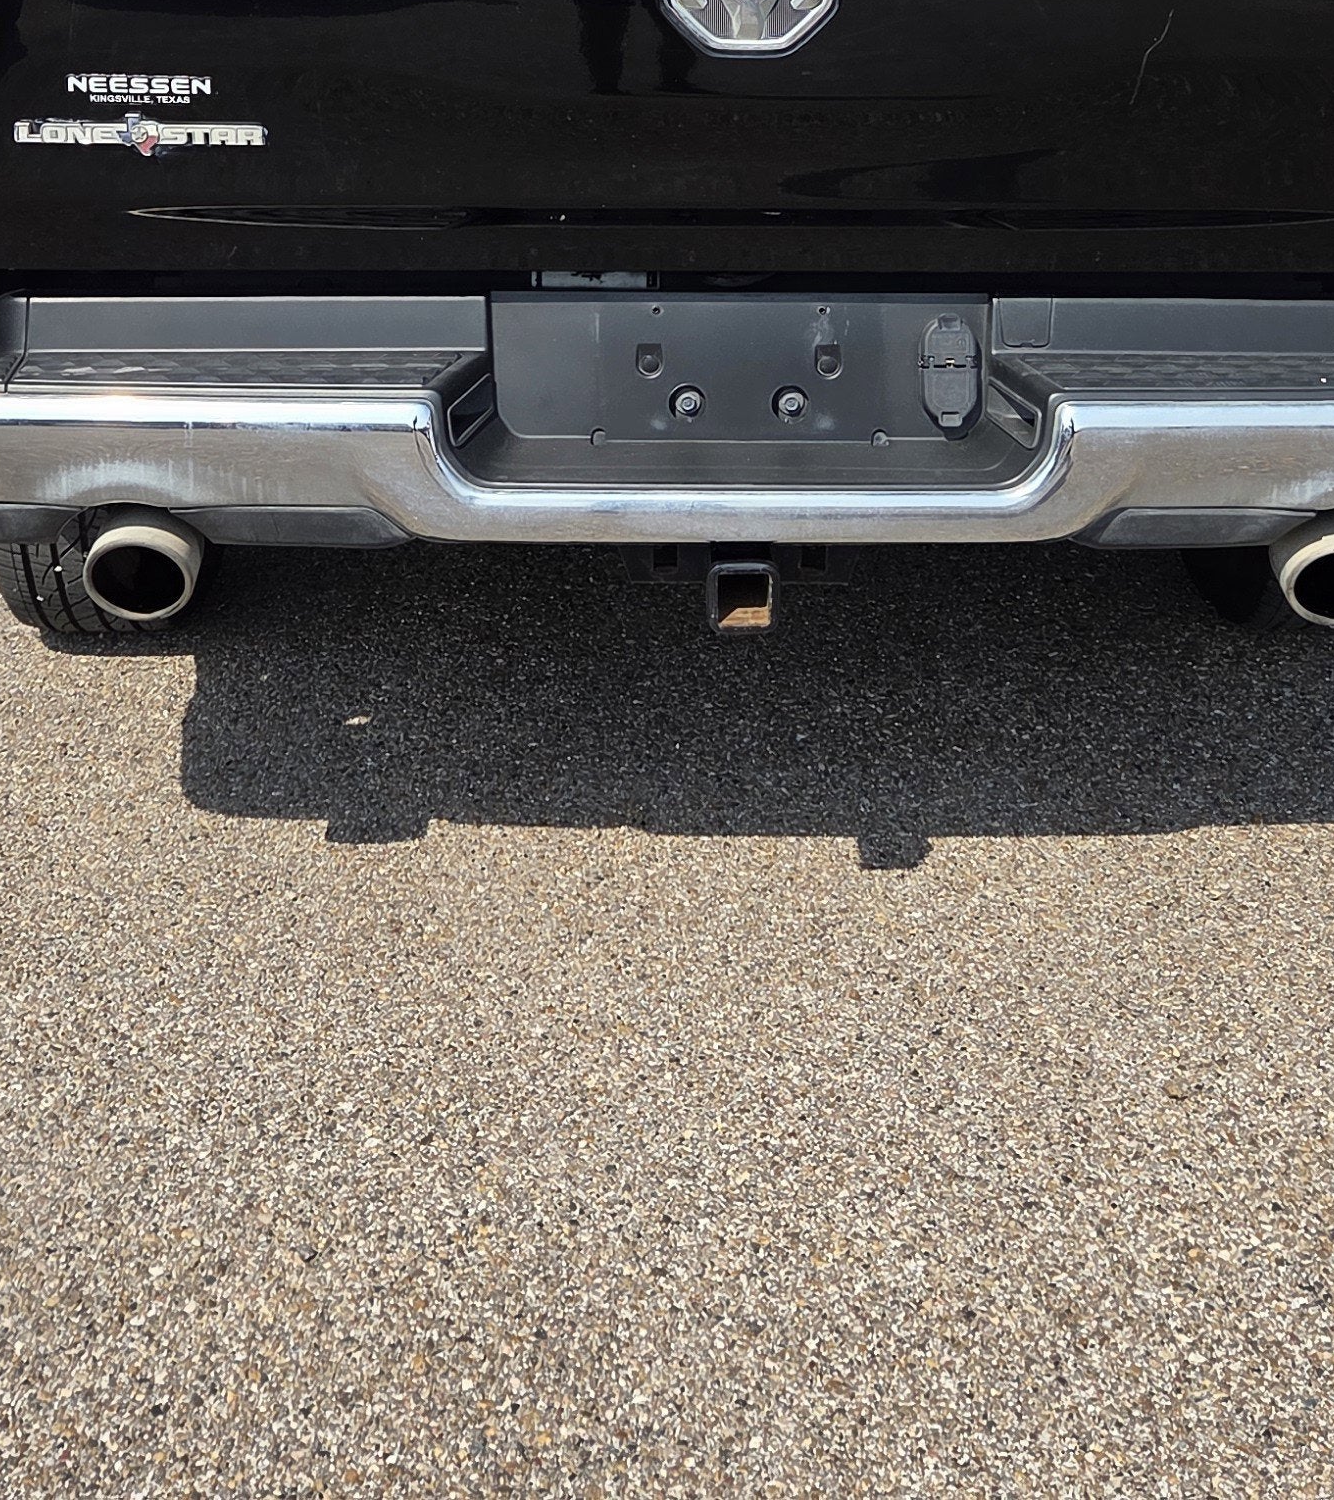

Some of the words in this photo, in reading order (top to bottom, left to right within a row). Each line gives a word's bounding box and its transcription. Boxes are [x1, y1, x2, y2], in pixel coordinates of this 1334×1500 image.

[67, 76, 212, 95] NEESSEN
[89, 94, 154, 104] KINGSVILLE,
[156, 96, 190, 104] TEXAS
[14, 121, 126, 144] LONE
[160, 124, 268, 146] STAR
